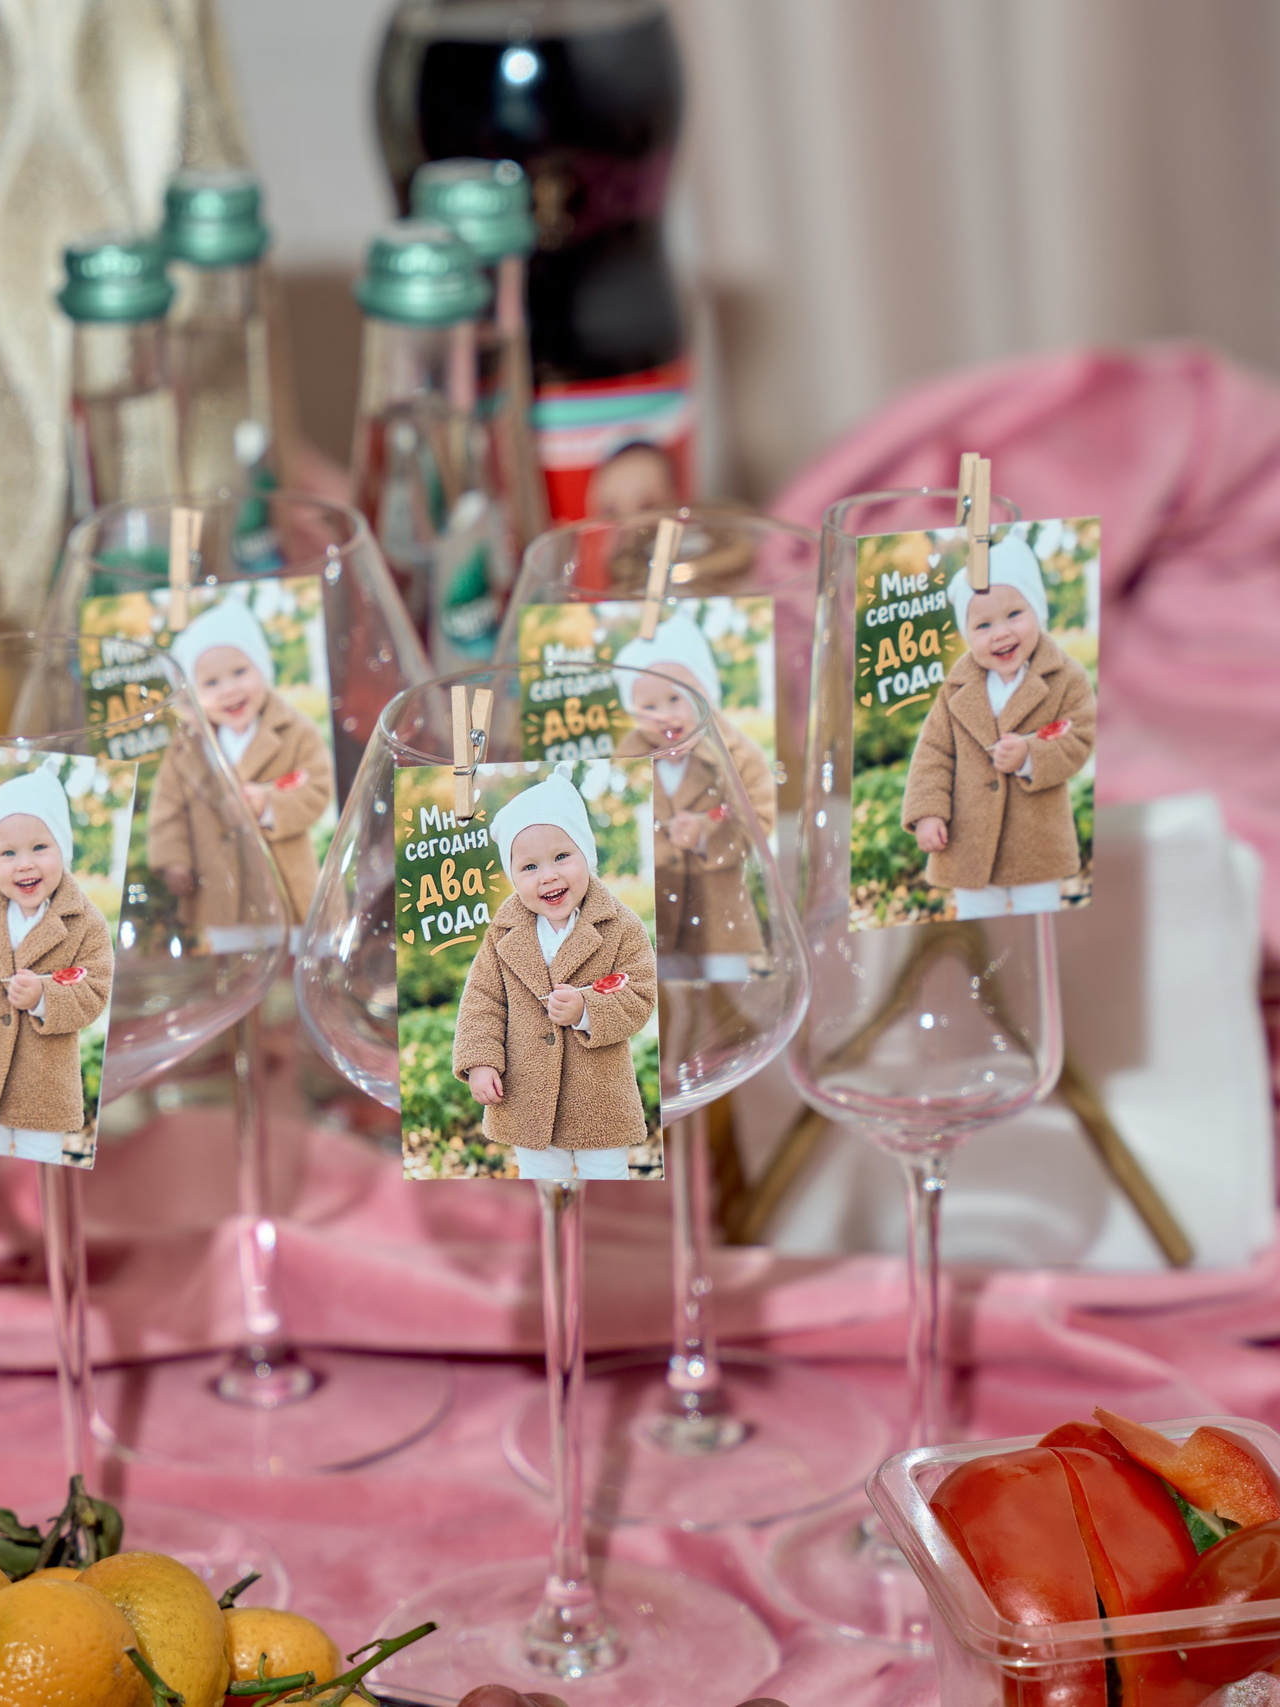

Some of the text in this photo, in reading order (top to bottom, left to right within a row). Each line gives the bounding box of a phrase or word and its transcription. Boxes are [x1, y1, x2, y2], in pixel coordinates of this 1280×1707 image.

[881, 570, 929, 600] Мне
[865, 590, 947, 627] сегодня
[544, 642, 595, 677] Мне
[875, 621, 941, 676] Два
[529, 672, 613, 702] сегодня
[877, 661, 945, 703] года
[542, 697, 609, 746] Два
[108, 725, 169, 760] года
[545, 733, 615, 762] года
[405, 828, 489, 861] сегодня
[416, 858, 486, 913] Два
[420, 902, 492, 942] года
